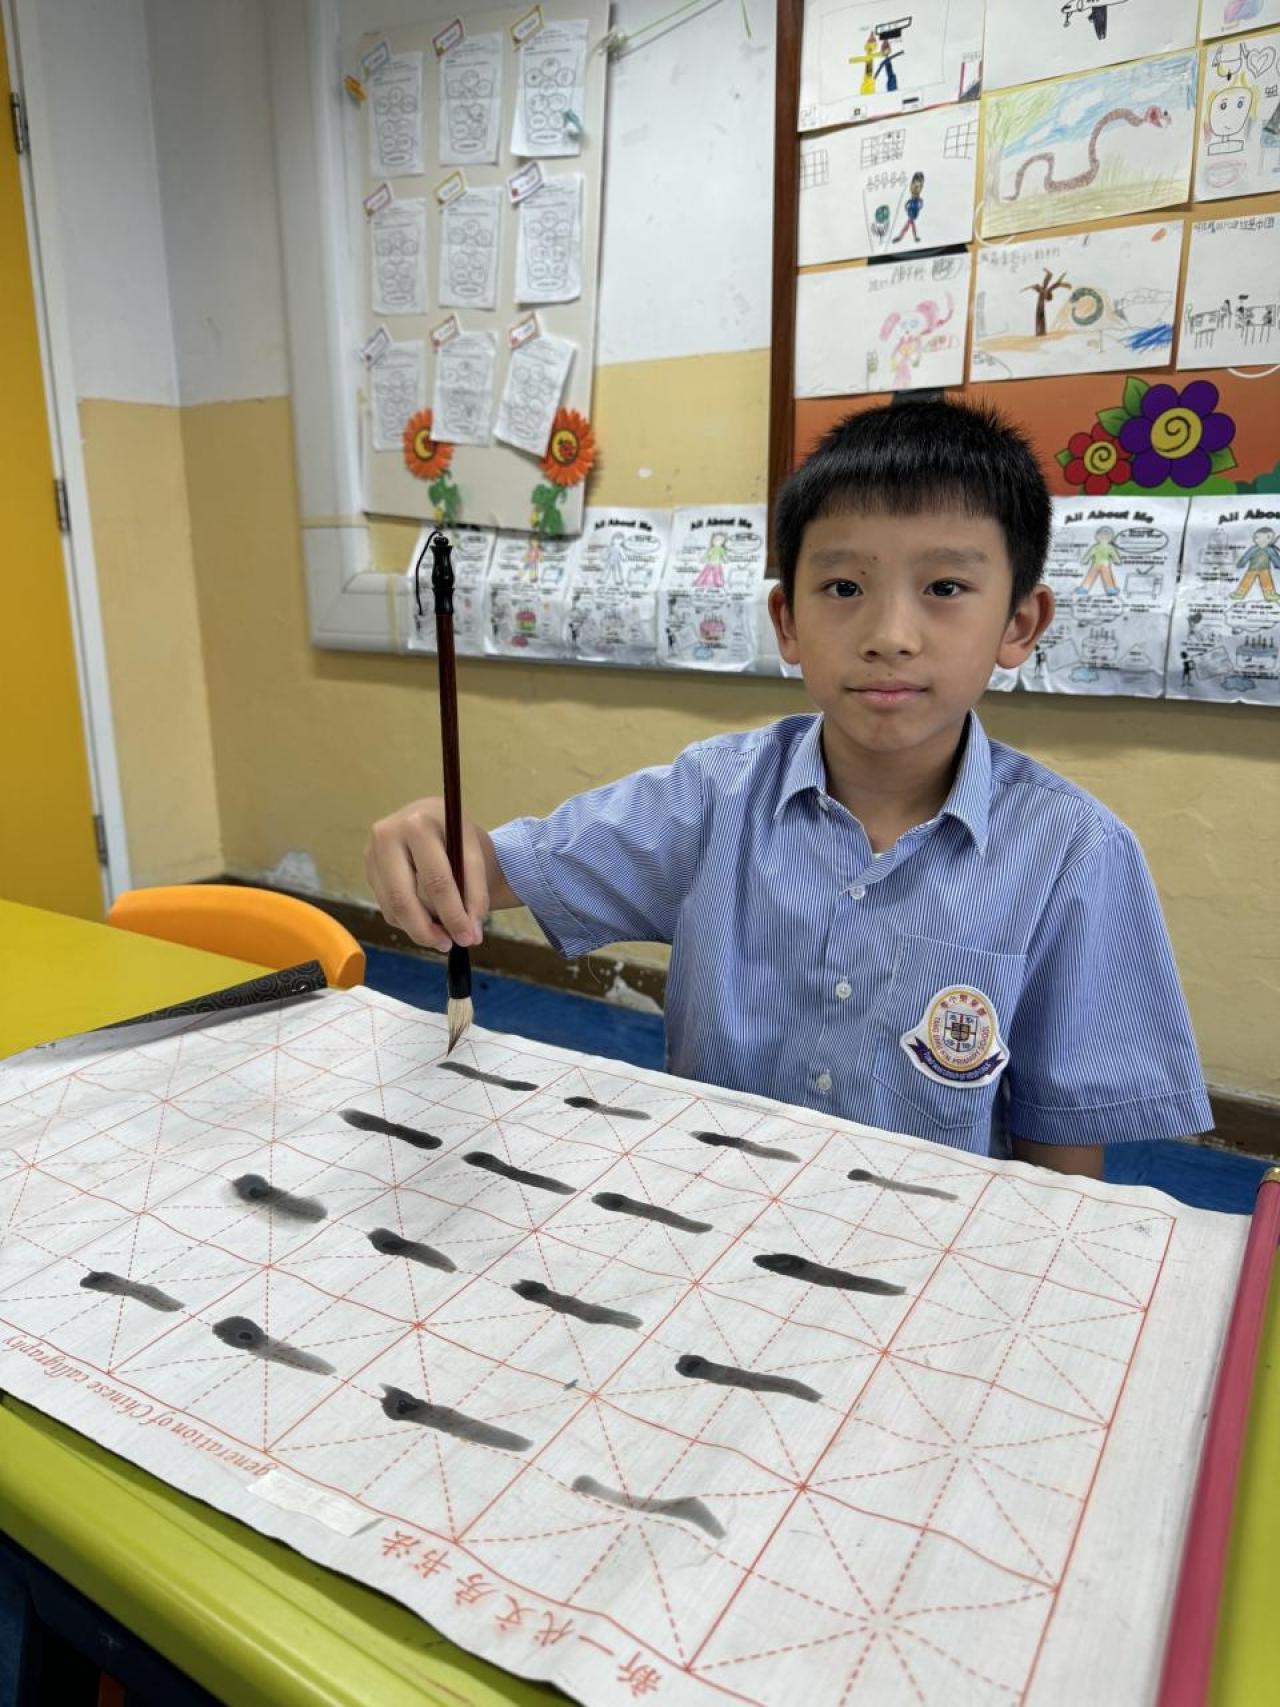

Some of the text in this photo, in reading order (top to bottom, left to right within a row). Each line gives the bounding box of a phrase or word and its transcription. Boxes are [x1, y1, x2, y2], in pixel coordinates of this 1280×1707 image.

[1064, 510, 1154, 524] All About Me
[1218, 511, 1238, 524] All
[2, 1335, 280, 1477] generation of Chinese calligraphy
